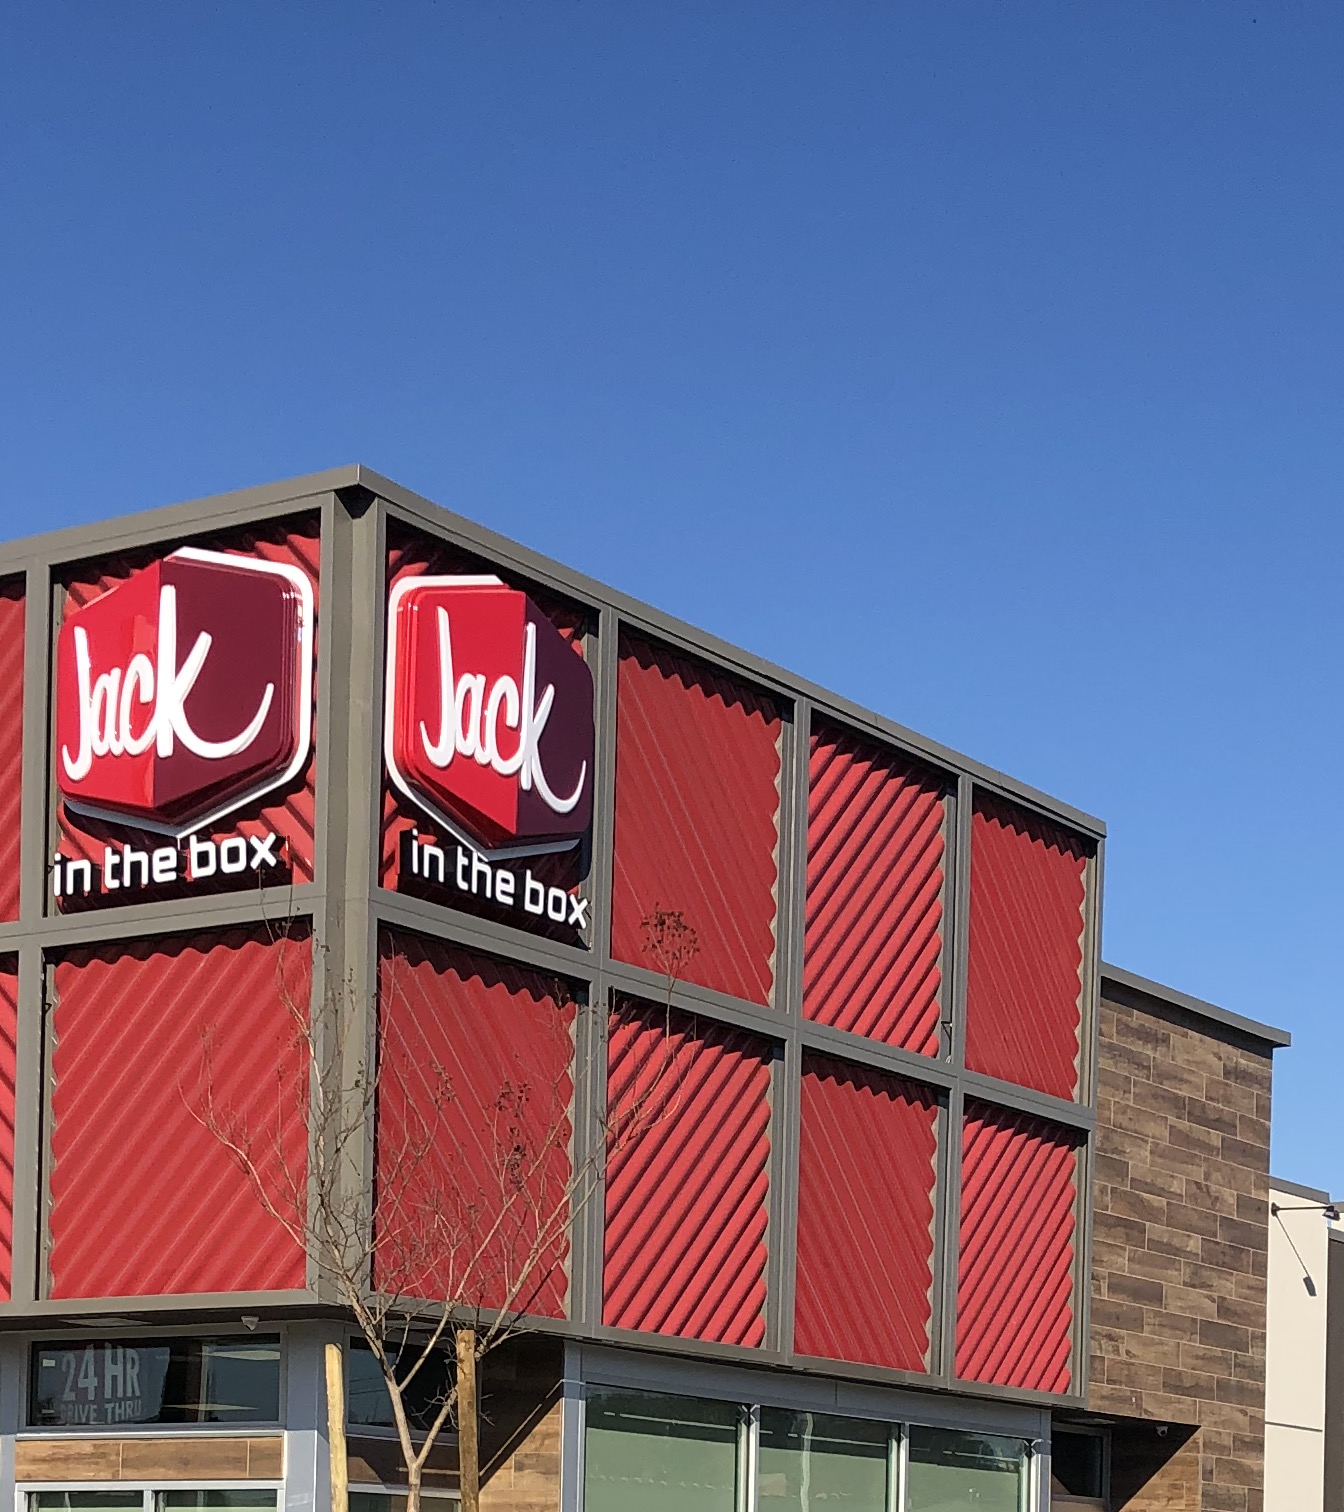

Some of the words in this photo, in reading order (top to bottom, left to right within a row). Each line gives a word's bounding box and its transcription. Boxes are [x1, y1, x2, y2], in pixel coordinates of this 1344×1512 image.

[62, 584, 274, 781] Jack
[420, 605, 587, 814] Jack
[53, 852, 92, 897] in
[104, 843, 178, 890] the
[189, 831, 277, 879] box
[412, 828, 445, 883] in
[456, 845, 516, 907] the
[524, 868, 589, 930] box
[61, 1343, 98, 1401] 24
[104, 1341, 141, 1399] HR
[104, 1400, 142, 1425] THRU
